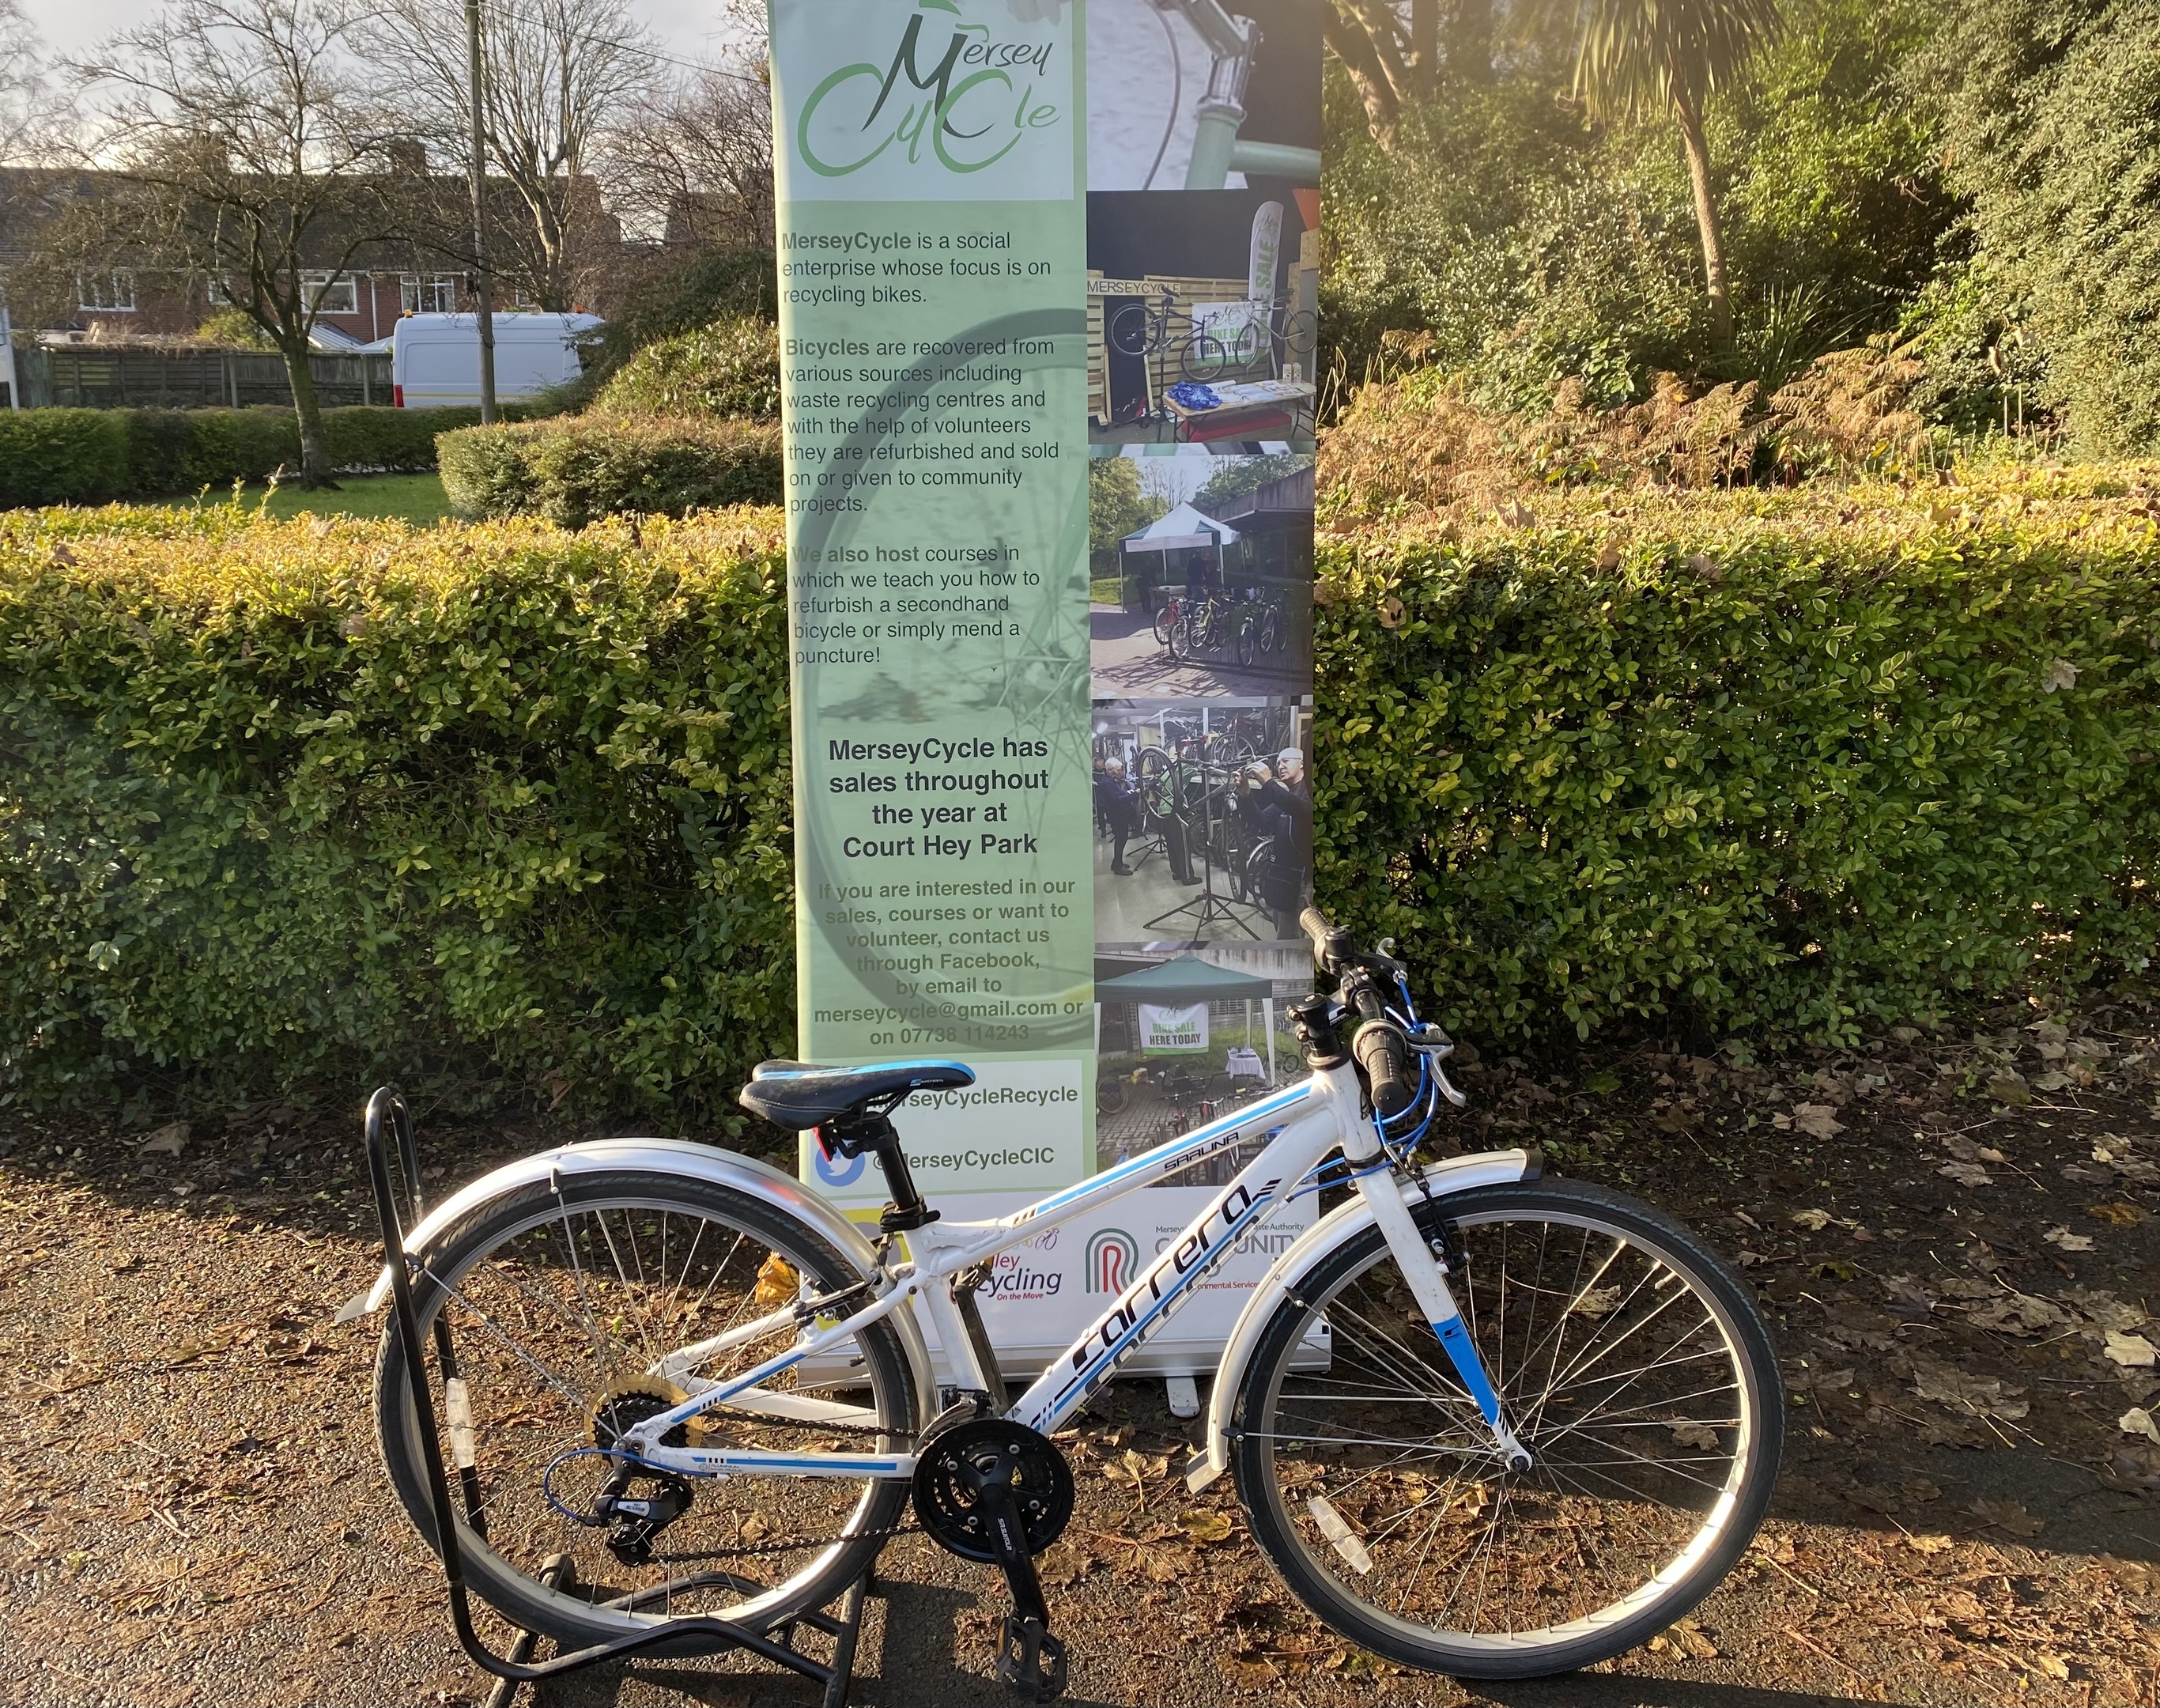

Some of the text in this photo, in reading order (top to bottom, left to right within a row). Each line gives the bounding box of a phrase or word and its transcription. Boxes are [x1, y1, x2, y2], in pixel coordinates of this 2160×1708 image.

[783, 232, 1010, 253] MerseyCycle is a social
[783, 259, 1051, 279] enterprise whose focus is on
[1256, 239, 1274, 289] SALE
[784, 285, 927, 306] recycling bikes.
[786, 338, 1055, 359] Bicycles are recovered from
[1203, 342, 1225, 355] HER
[786, 365, 1022, 384] various sources including
[787, 391, 1045, 411] waste recycling centres and
[787, 417, 1031, 437] with the help of volunteers
[789, 442, 1059, 463] they are refurbished and sold
[790, 468, 1022, 489] on or given to community
[791, 496, 867, 516] projects.
[791, 545, 1019, 563] We also host courses in
[793, 571, 1040, 590] which we teach you how to
[794, 595, 1009, 614] refurbish a secondhand
[794, 621, 1020, 642] bicycle or simply mend a
[795, 647, 880, 667] puncture!
[829, 737, 1048, 764] MerseyCycle has
[829, 769, 1049, 795] sales throughout
[872, 803, 1007, 828] the year at
[843, 833, 1038, 860] Court Hey Park
[819, 879, 1075, 903] If you are interested in our
[825, 903, 1069, 925] sales, courses or want to
[846, 928, 1050, 948] volunteer, contact us
[856, 952, 1040, 973] through Facebook,
[896, 977, 1002, 998] by email to
[814, 1001, 1083, 1024] merseycycle@gmail.com or
[870, 1025, 1029, 1045] on 07738 114243
[1153, 1021, 1196, 1033] BIKE SALE
[1150, 1033, 1201, 1045] HERE TODAY
[872, 1086, 1078, 1110] rseyCycleRecycle
[1156, 1225, 1186, 1234] Merseys
[1271, 1222, 1305, 1231] Authority
[995, 1254, 1021, 1272] ley
[1071, 1184, 1253, 1377] carrera
